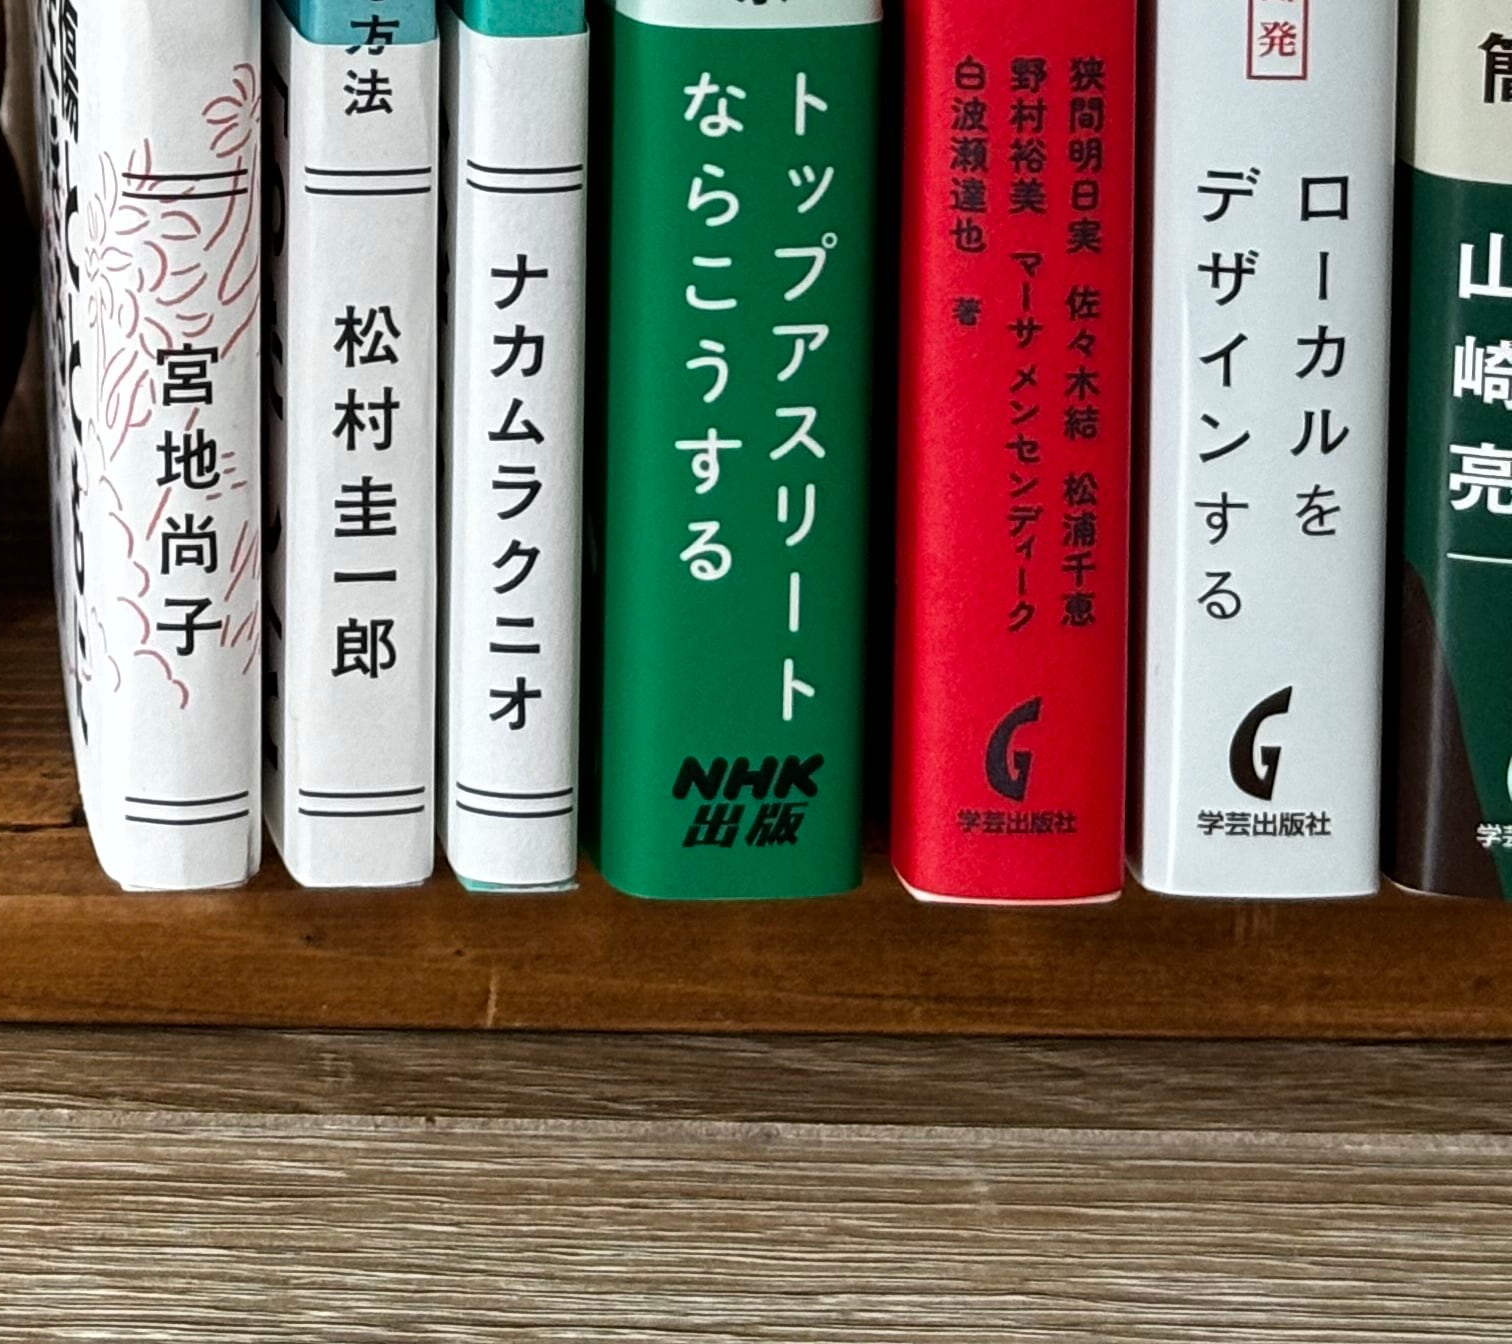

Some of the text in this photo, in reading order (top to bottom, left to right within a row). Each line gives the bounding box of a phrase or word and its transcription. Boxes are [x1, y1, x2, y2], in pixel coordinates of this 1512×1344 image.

[949, 54, 987, 253] 白波瀬達也
[1009, 56, 1047, 215] 野村裕美
[1066, 56, 1105, 254] 狭間明日実
[675, 74, 745, 582] ならこうする
[769, 72, 838, 723] トップアスリート
[1064, 284, 1101, 441] 佐々木結
[1194, 166, 1261, 622] デザインする
[1290, 172, 1351, 537] ローカルを
[156, 343, 223, 658] 宮地尚子
[331, 304, 402, 679] 松村圭一郎
[488, 253, 549, 732] ナカムラクニオ
[671, 753, 825, 800] NHK
[682, 801, 809, 849] 出版
[957, 811, 1077, 838] 学芸出版社
[1197, 810, 1332, 838] 学芸出版社
